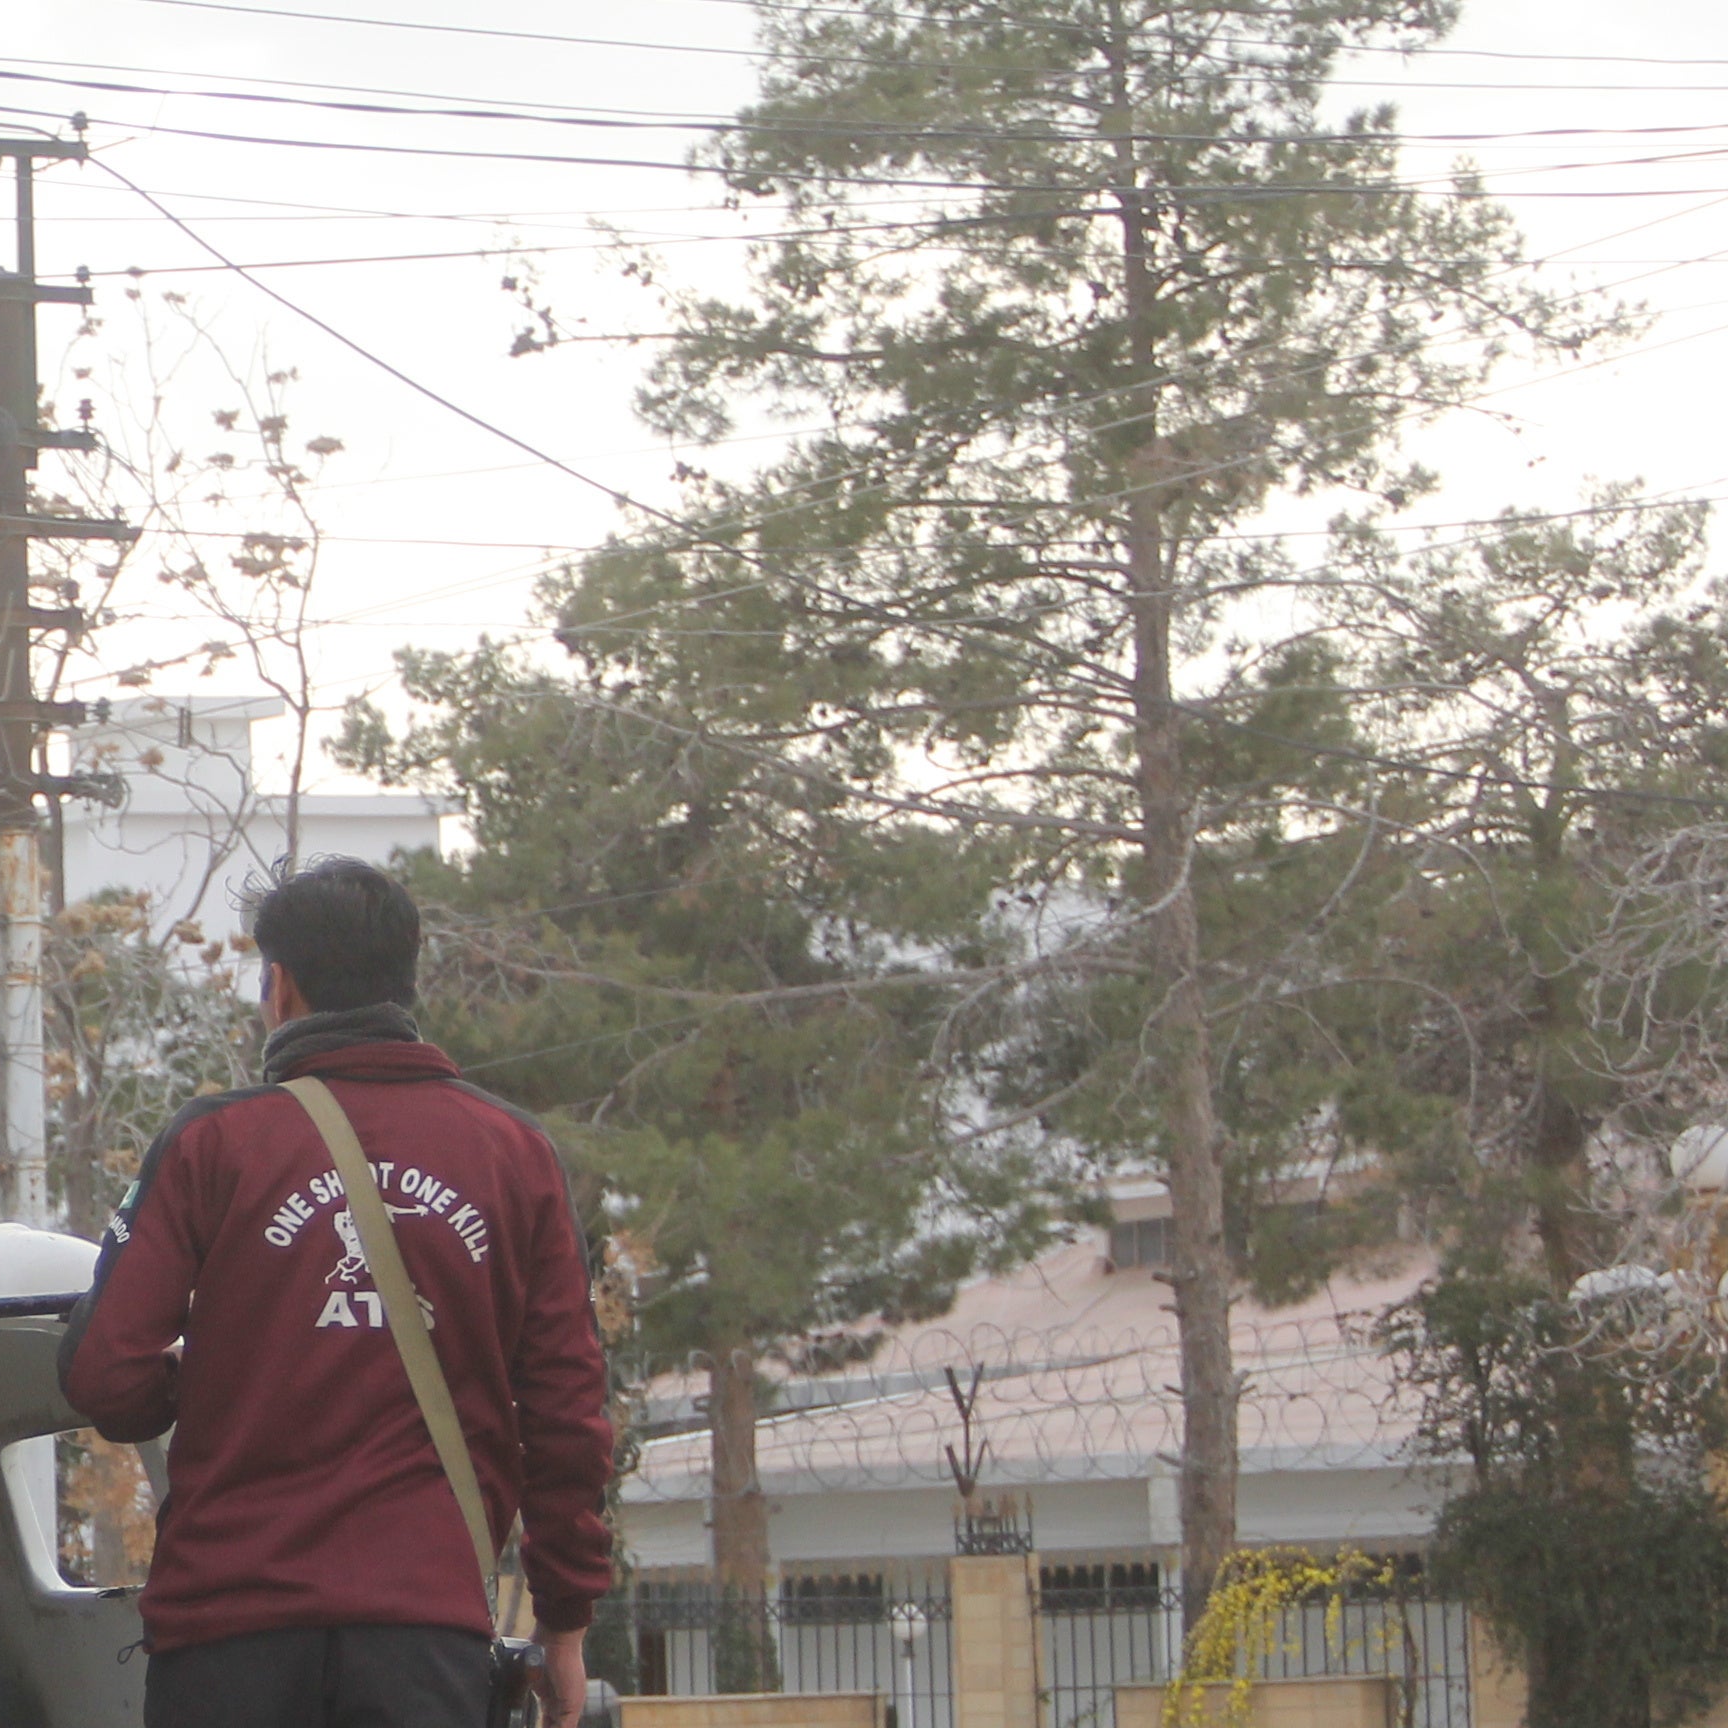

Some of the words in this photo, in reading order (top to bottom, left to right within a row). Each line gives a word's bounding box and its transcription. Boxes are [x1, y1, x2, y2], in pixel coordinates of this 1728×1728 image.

[264, 1192, 315, 1247] ONE
[309, 1161, 394, 1205] SHT
[400, 1167, 458, 1214] ONE
[447, 1203, 490, 1263] KILL
